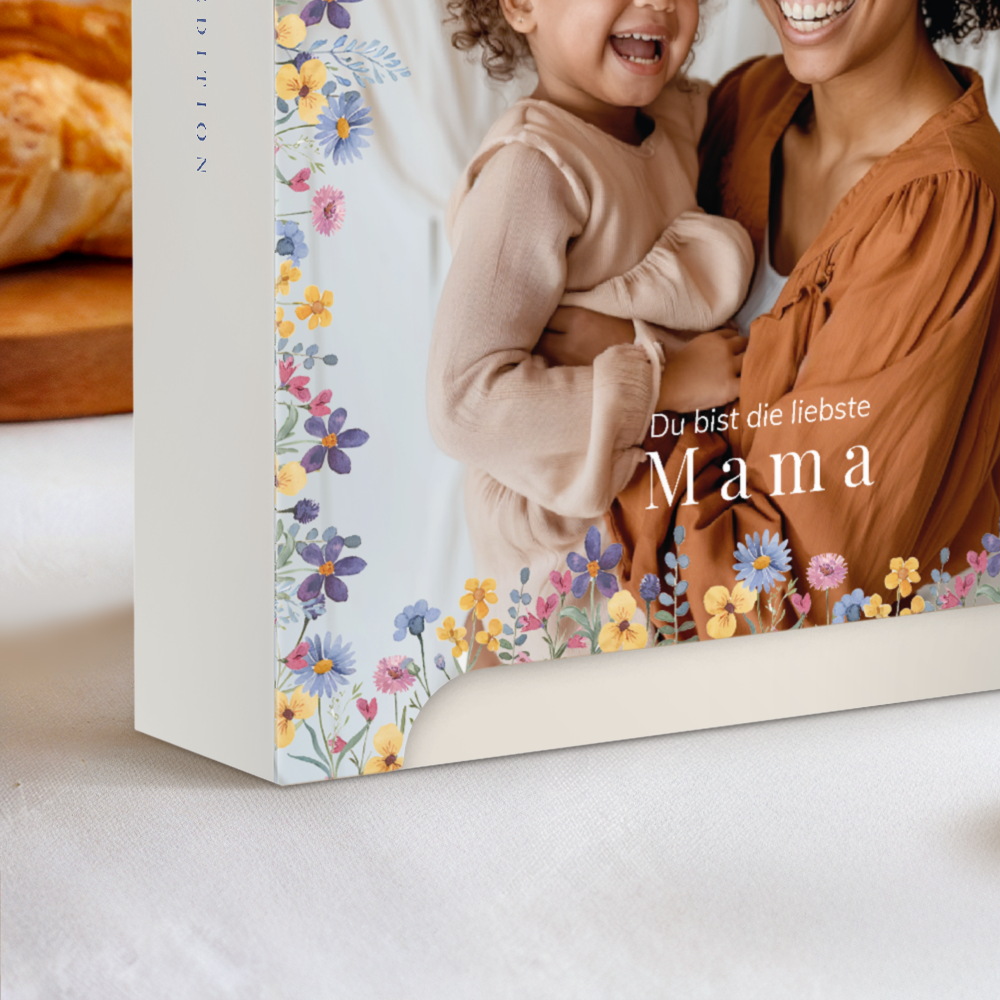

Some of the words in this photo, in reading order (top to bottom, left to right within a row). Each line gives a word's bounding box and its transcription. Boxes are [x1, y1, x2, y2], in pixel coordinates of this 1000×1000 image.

[650, 412, 686, 439] Du
[694, 407, 741, 434] bist
[746, 402, 783, 429] die
[790, 396, 871, 425] liebste
[645, 444, 876, 511] Mama
